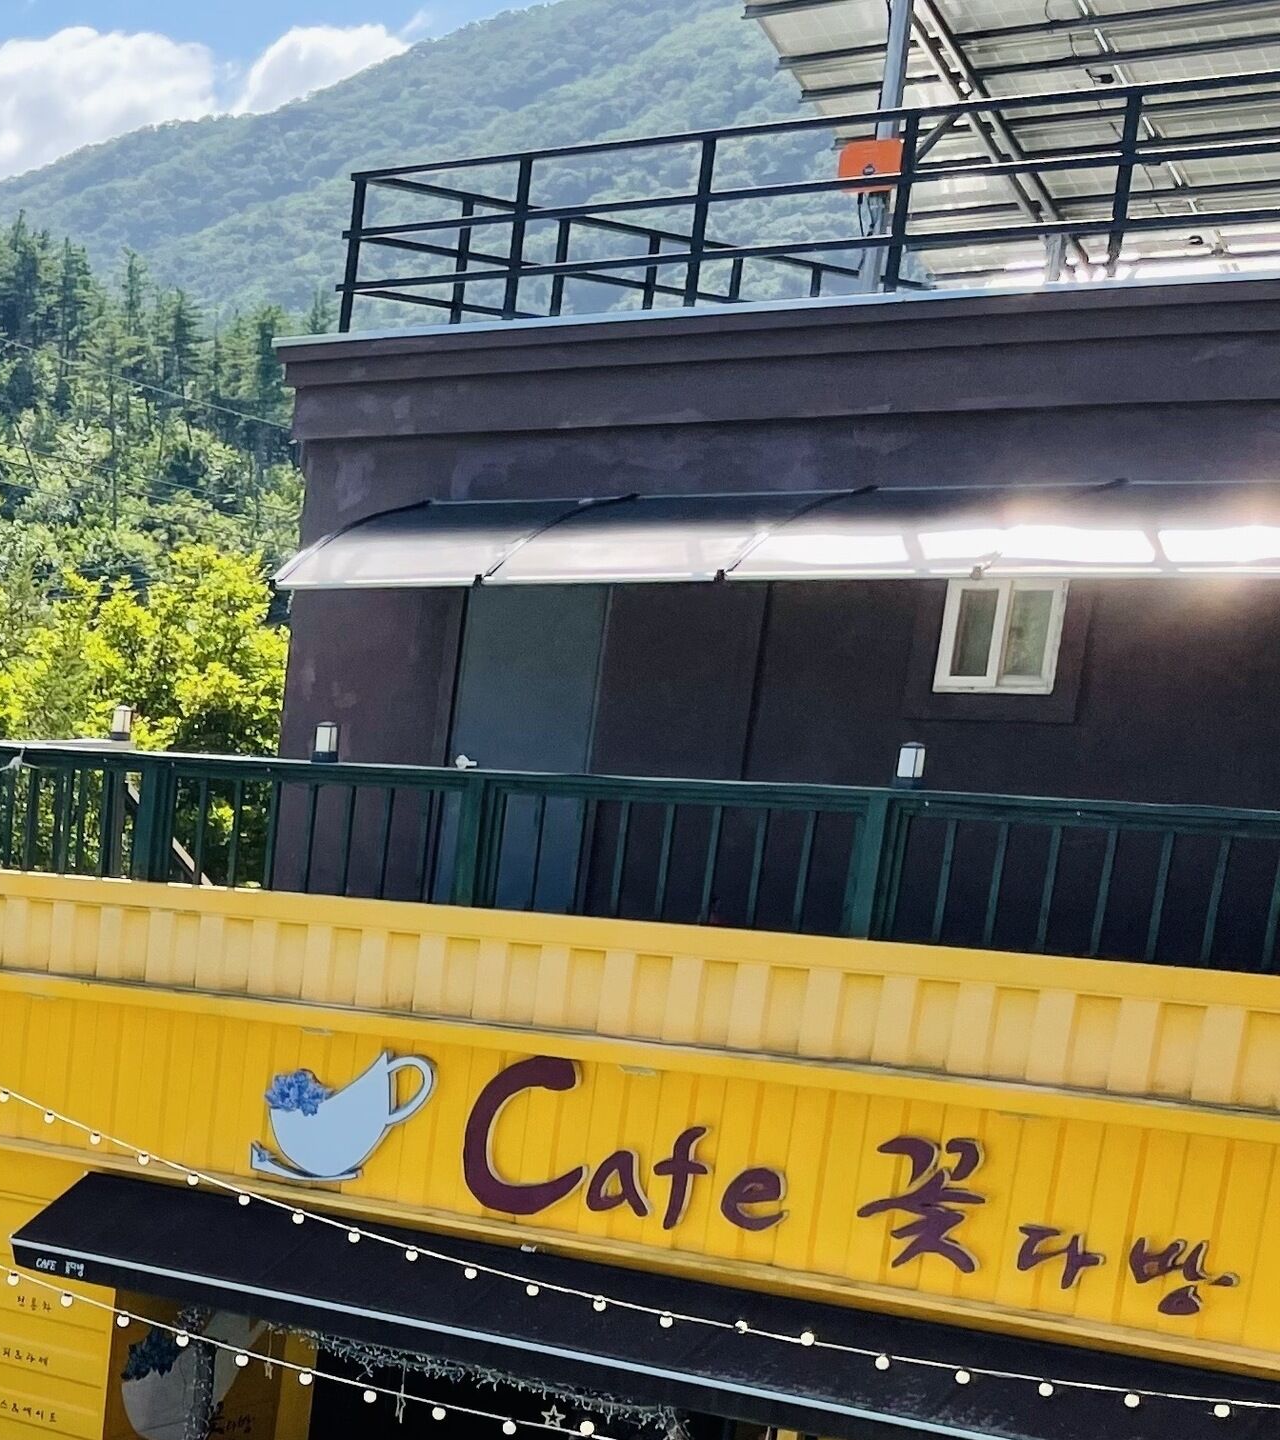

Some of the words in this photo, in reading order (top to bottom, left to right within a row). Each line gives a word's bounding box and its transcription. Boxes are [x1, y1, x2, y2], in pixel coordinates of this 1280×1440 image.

[462, 1055, 788, 1231] Cafe
[856, 1136, 1239, 1316] 꽃다방
[36, 1258, 57, 1271] CAFE
